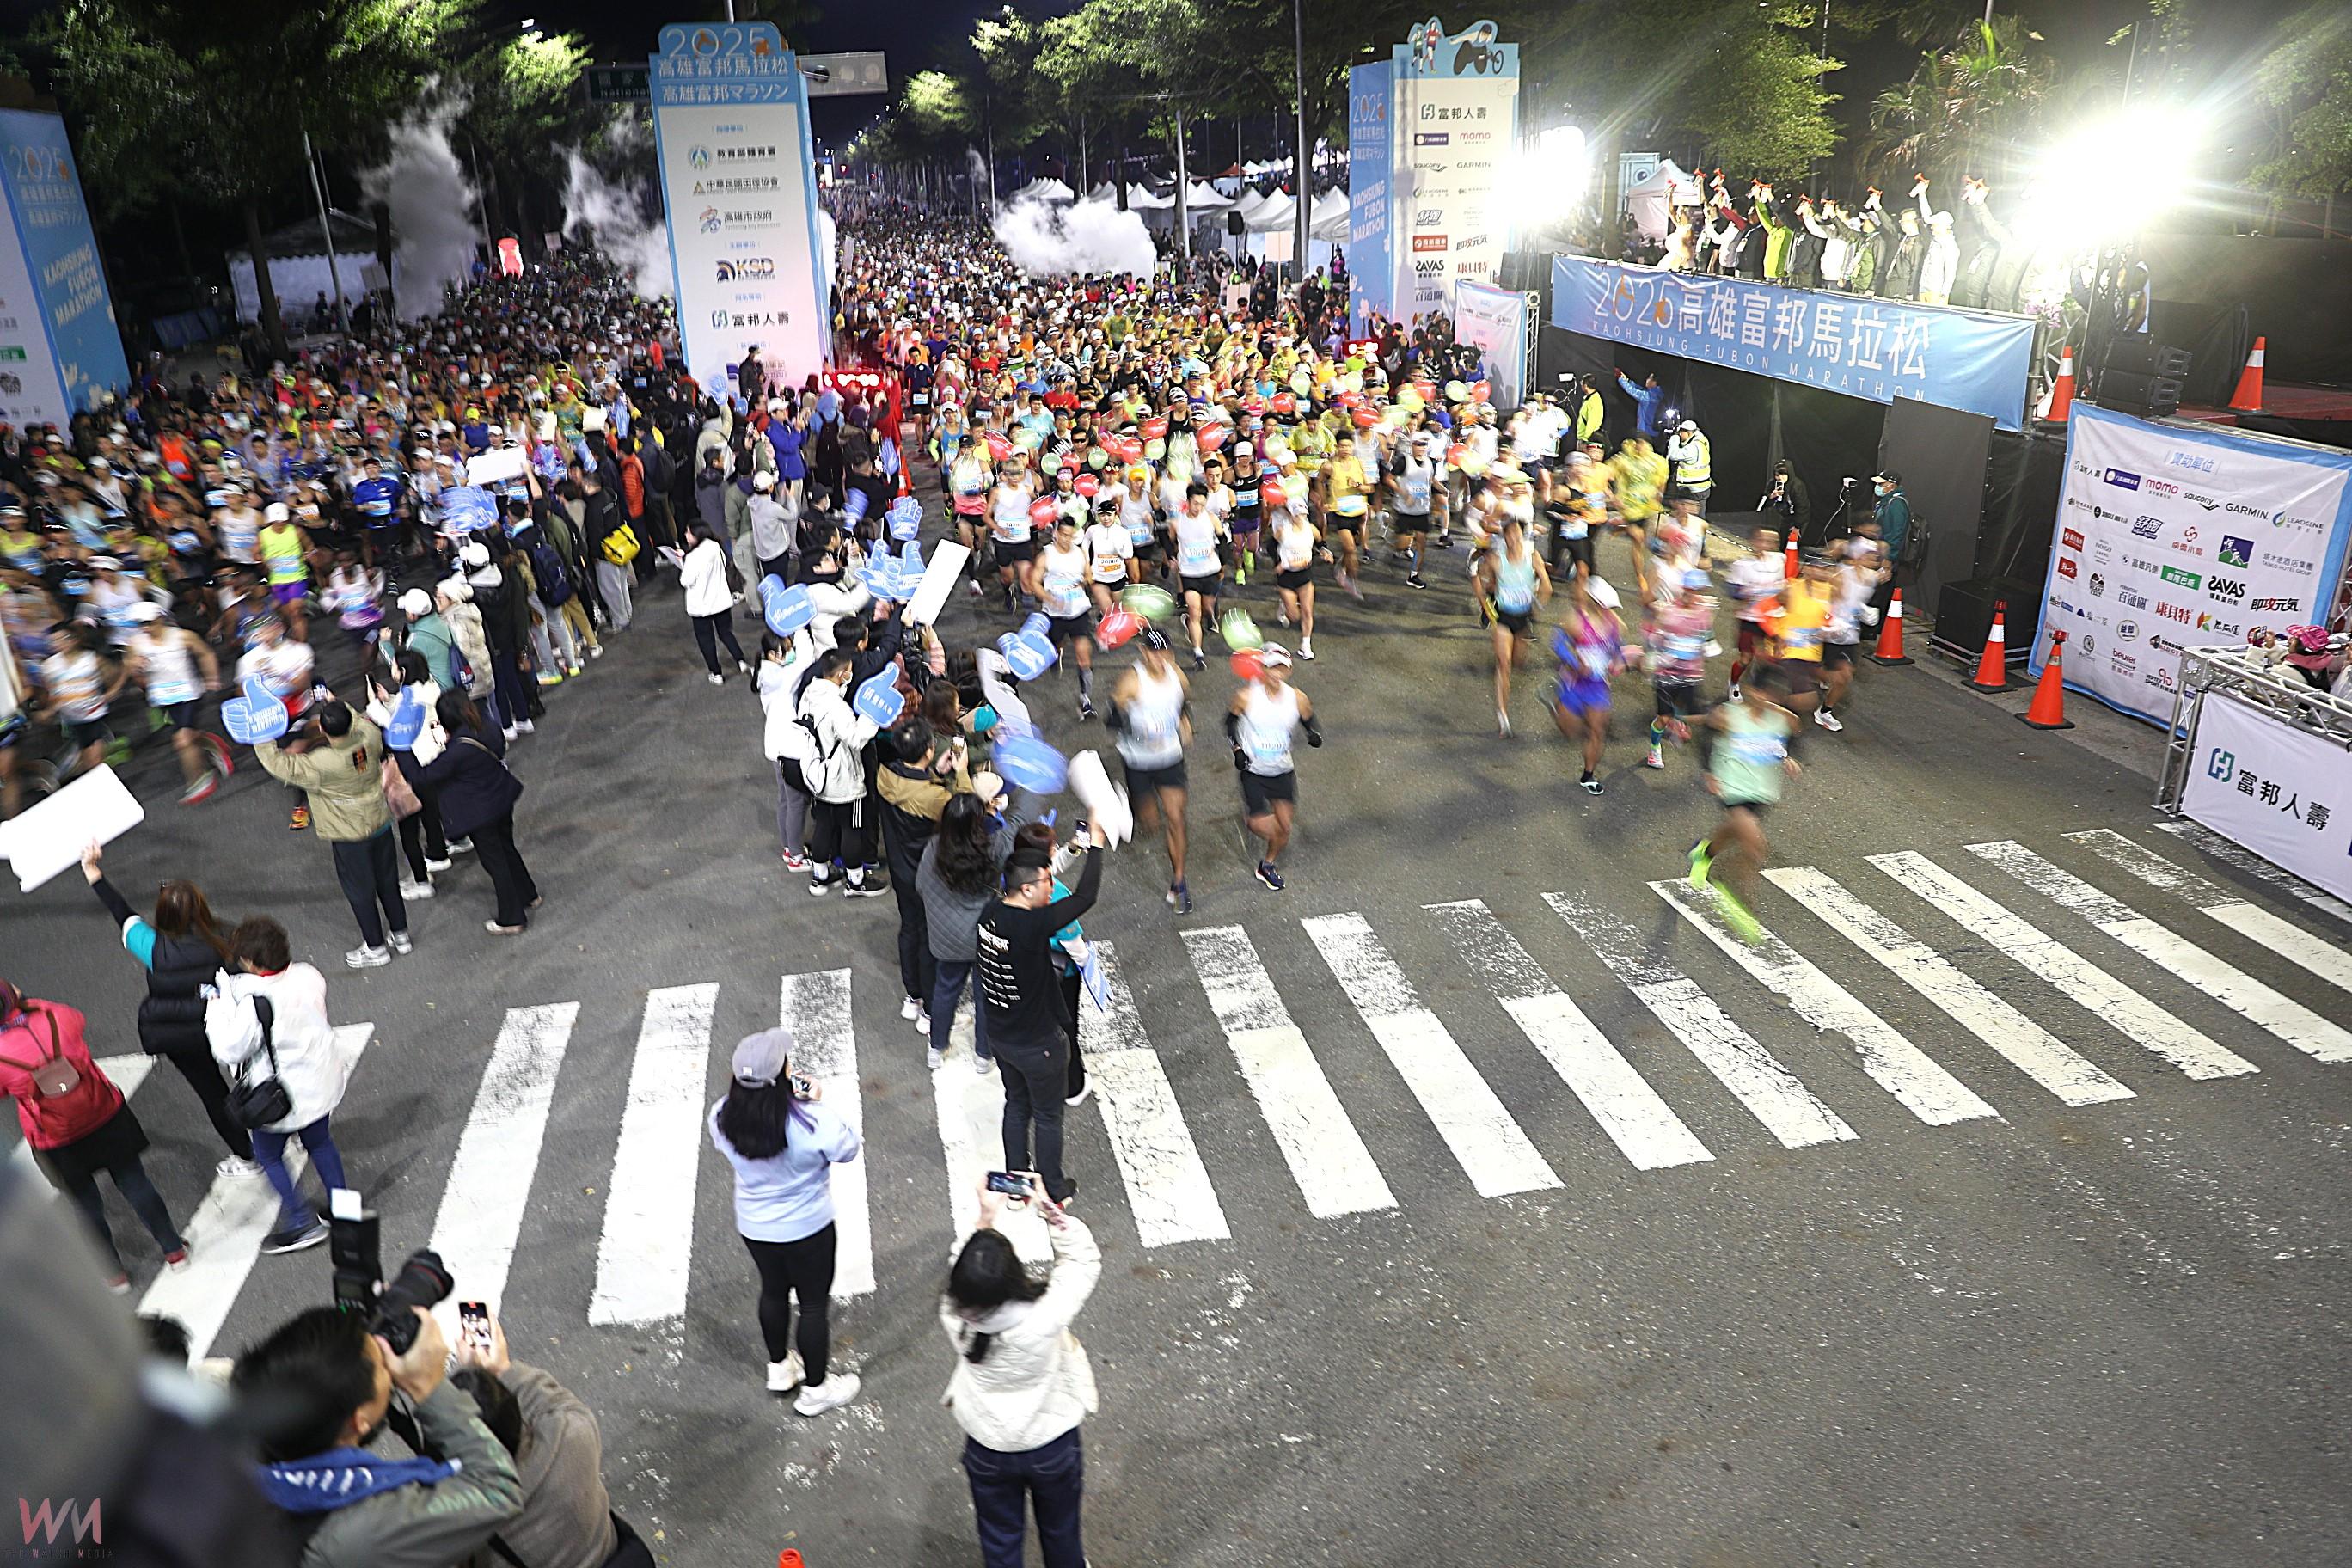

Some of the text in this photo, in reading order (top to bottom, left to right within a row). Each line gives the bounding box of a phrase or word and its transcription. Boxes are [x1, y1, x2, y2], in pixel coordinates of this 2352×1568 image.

[658, 56, 788, 77] 高雄富邦馬拉松
[663, 83, 789, 103] 高雄富邦マラソン
[1438, 107, 1487, 120] 富邦人壽
[1460, 132, 1491, 141] momo
[1456, 161, 1491, 169] GARMIN
[724, 210, 772, 224] 高雄市政府
[1364, 199, 1385, 221] FUBON
[1353, 216, 1385, 243] MARATHON
[736, 258, 775, 274] KSD
[1416, 260, 1444, 272] SAVAS
[67, 263, 98, 294] FUBON
[54, 283, 103, 328] MARATHON
[732, 312, 789, 327] 富邦人壽
[1593, 321, 1926, 401] KAOHSIUNG FUBON MARATHON
[2146, 478, 2179, 494] momo
[2184, 493, 2214, 505] saucony
[2135, 516, 2162, 533] 舒跑
[2287, 518, 2324, 530] LEADGENE
[2208, 575, 2246, 598] SAVAS
[2119, 591, 2147, 610] 百通關
[2155, 602, 2191, 625] 康貝特
[2112, 648, 2136, 664] beurer
[2237, 769, 2331, 831] 富邦人壽
